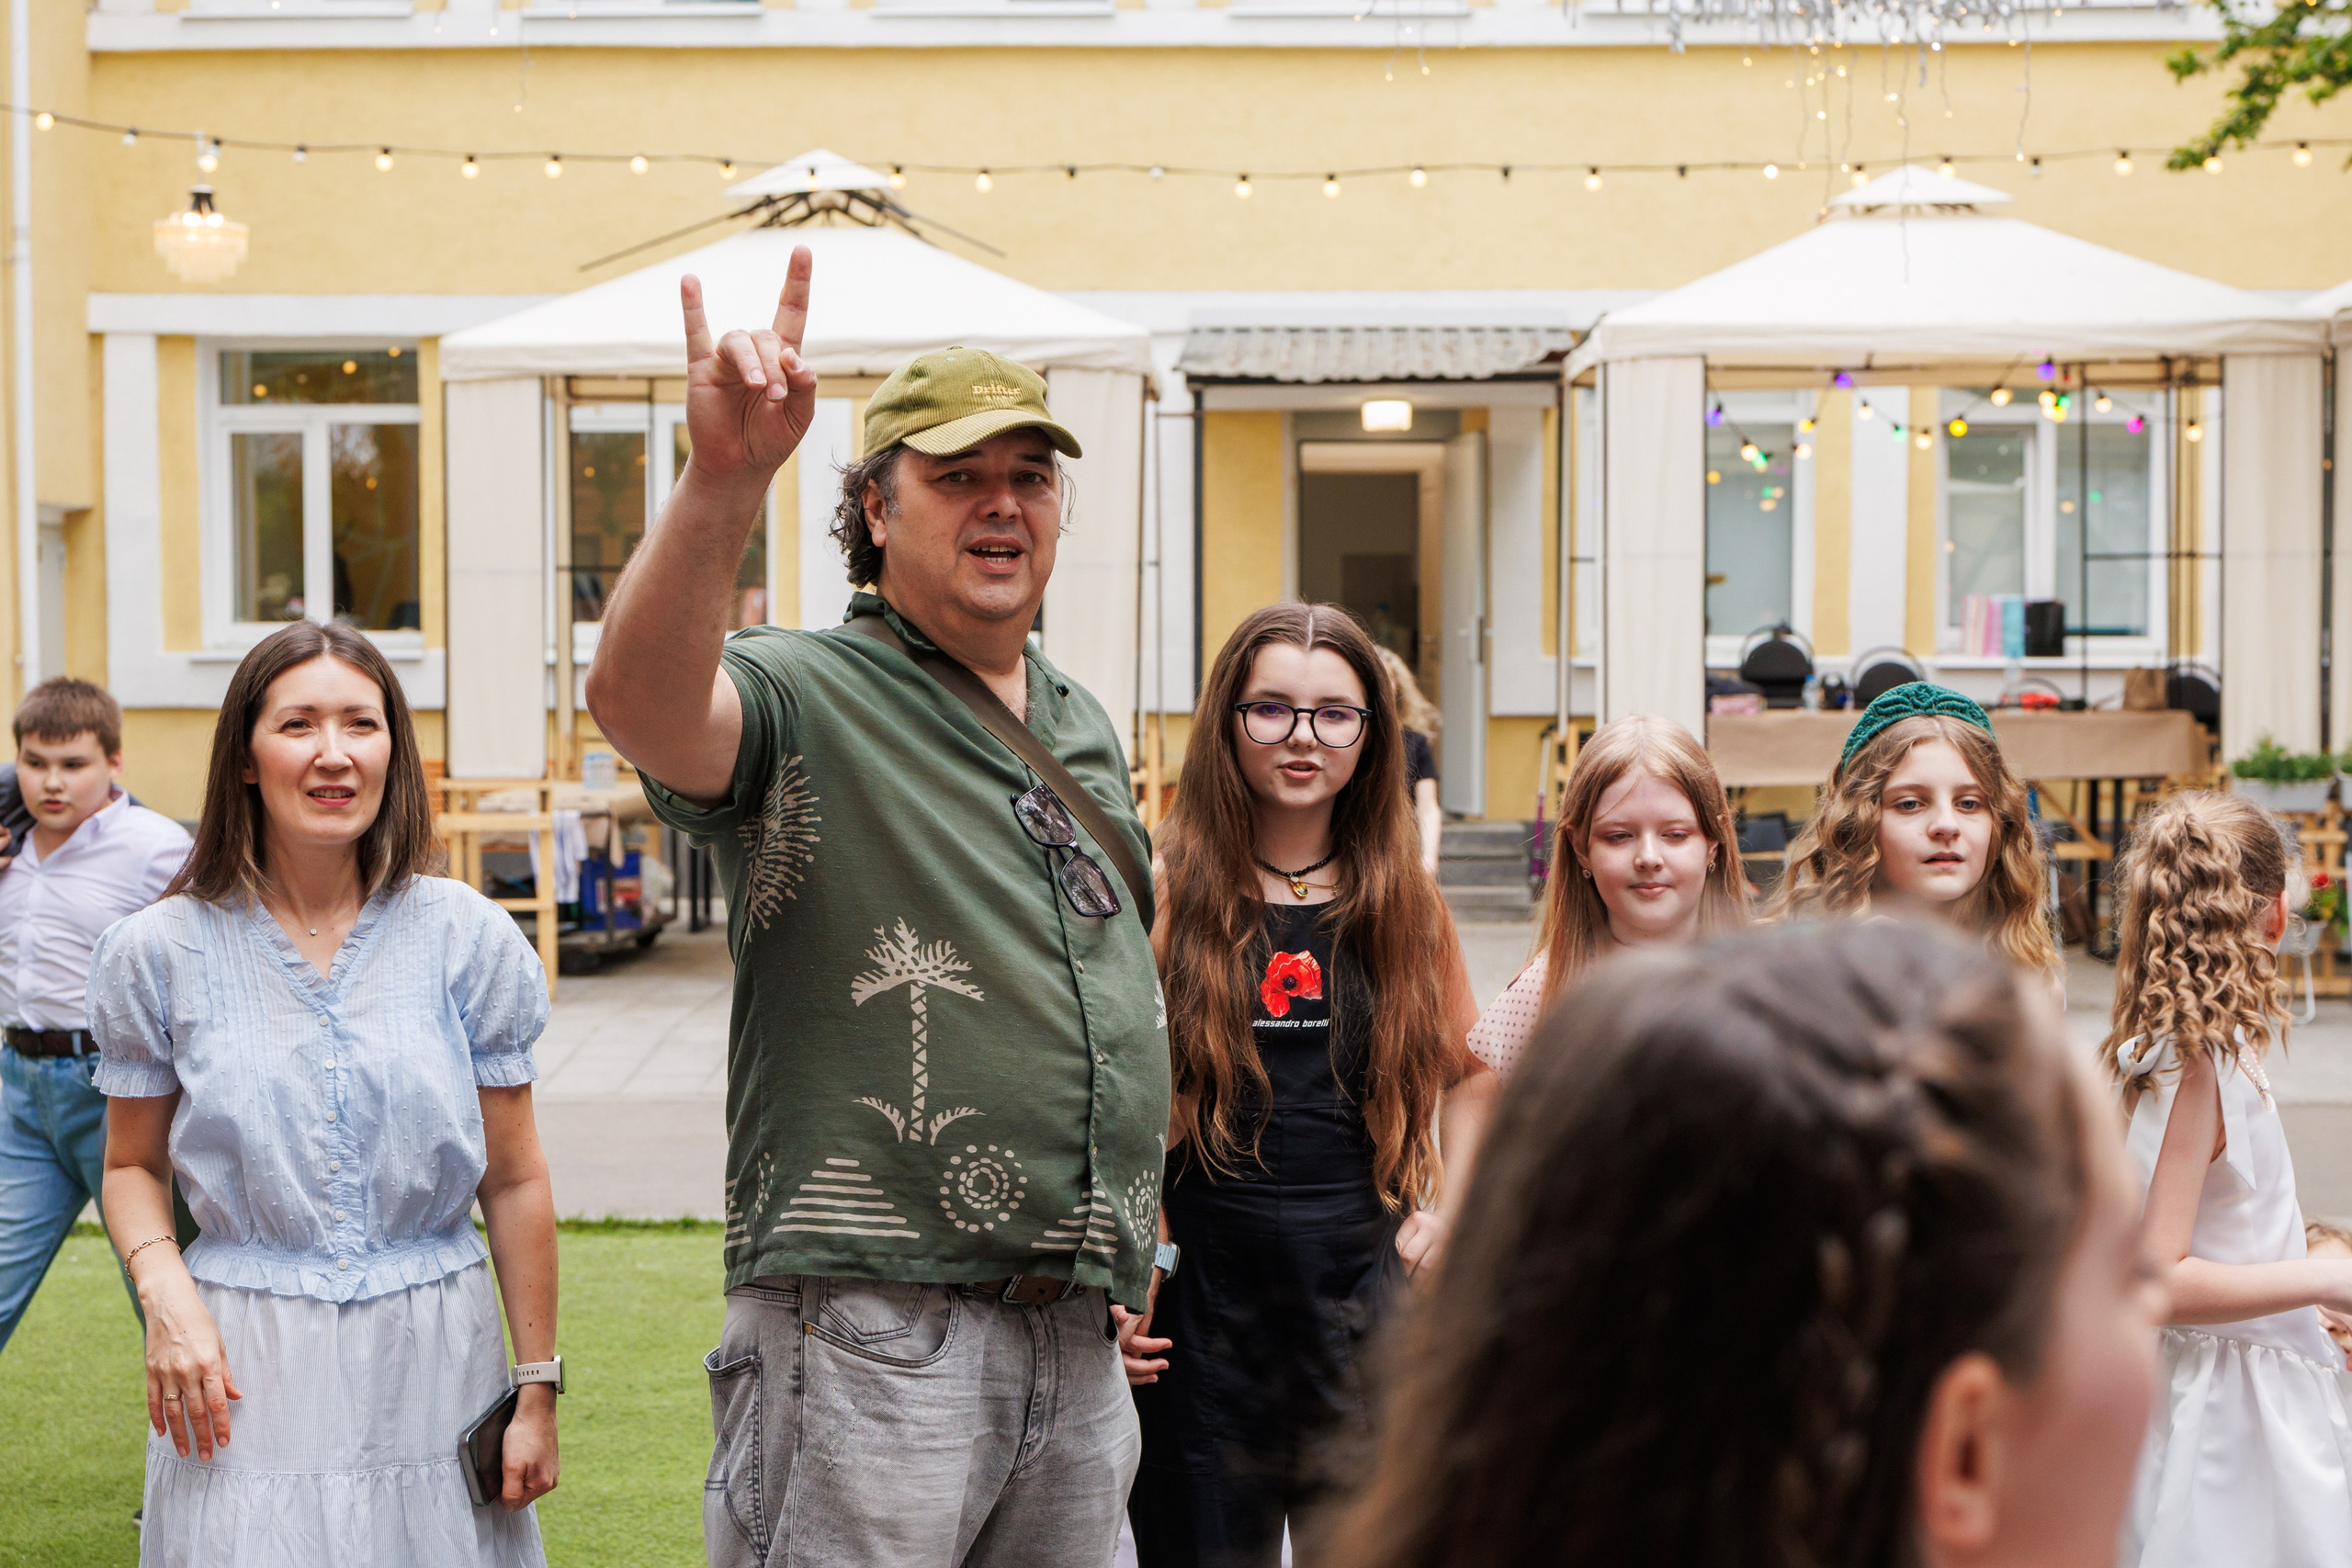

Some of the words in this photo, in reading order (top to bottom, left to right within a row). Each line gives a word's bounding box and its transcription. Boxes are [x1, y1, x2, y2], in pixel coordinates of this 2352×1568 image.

[972, 383, 1022, 395] Drifter
[1251, 1019, 1301, 1028] alessandro
[1301, 1018, 1330, 1028] borelli
